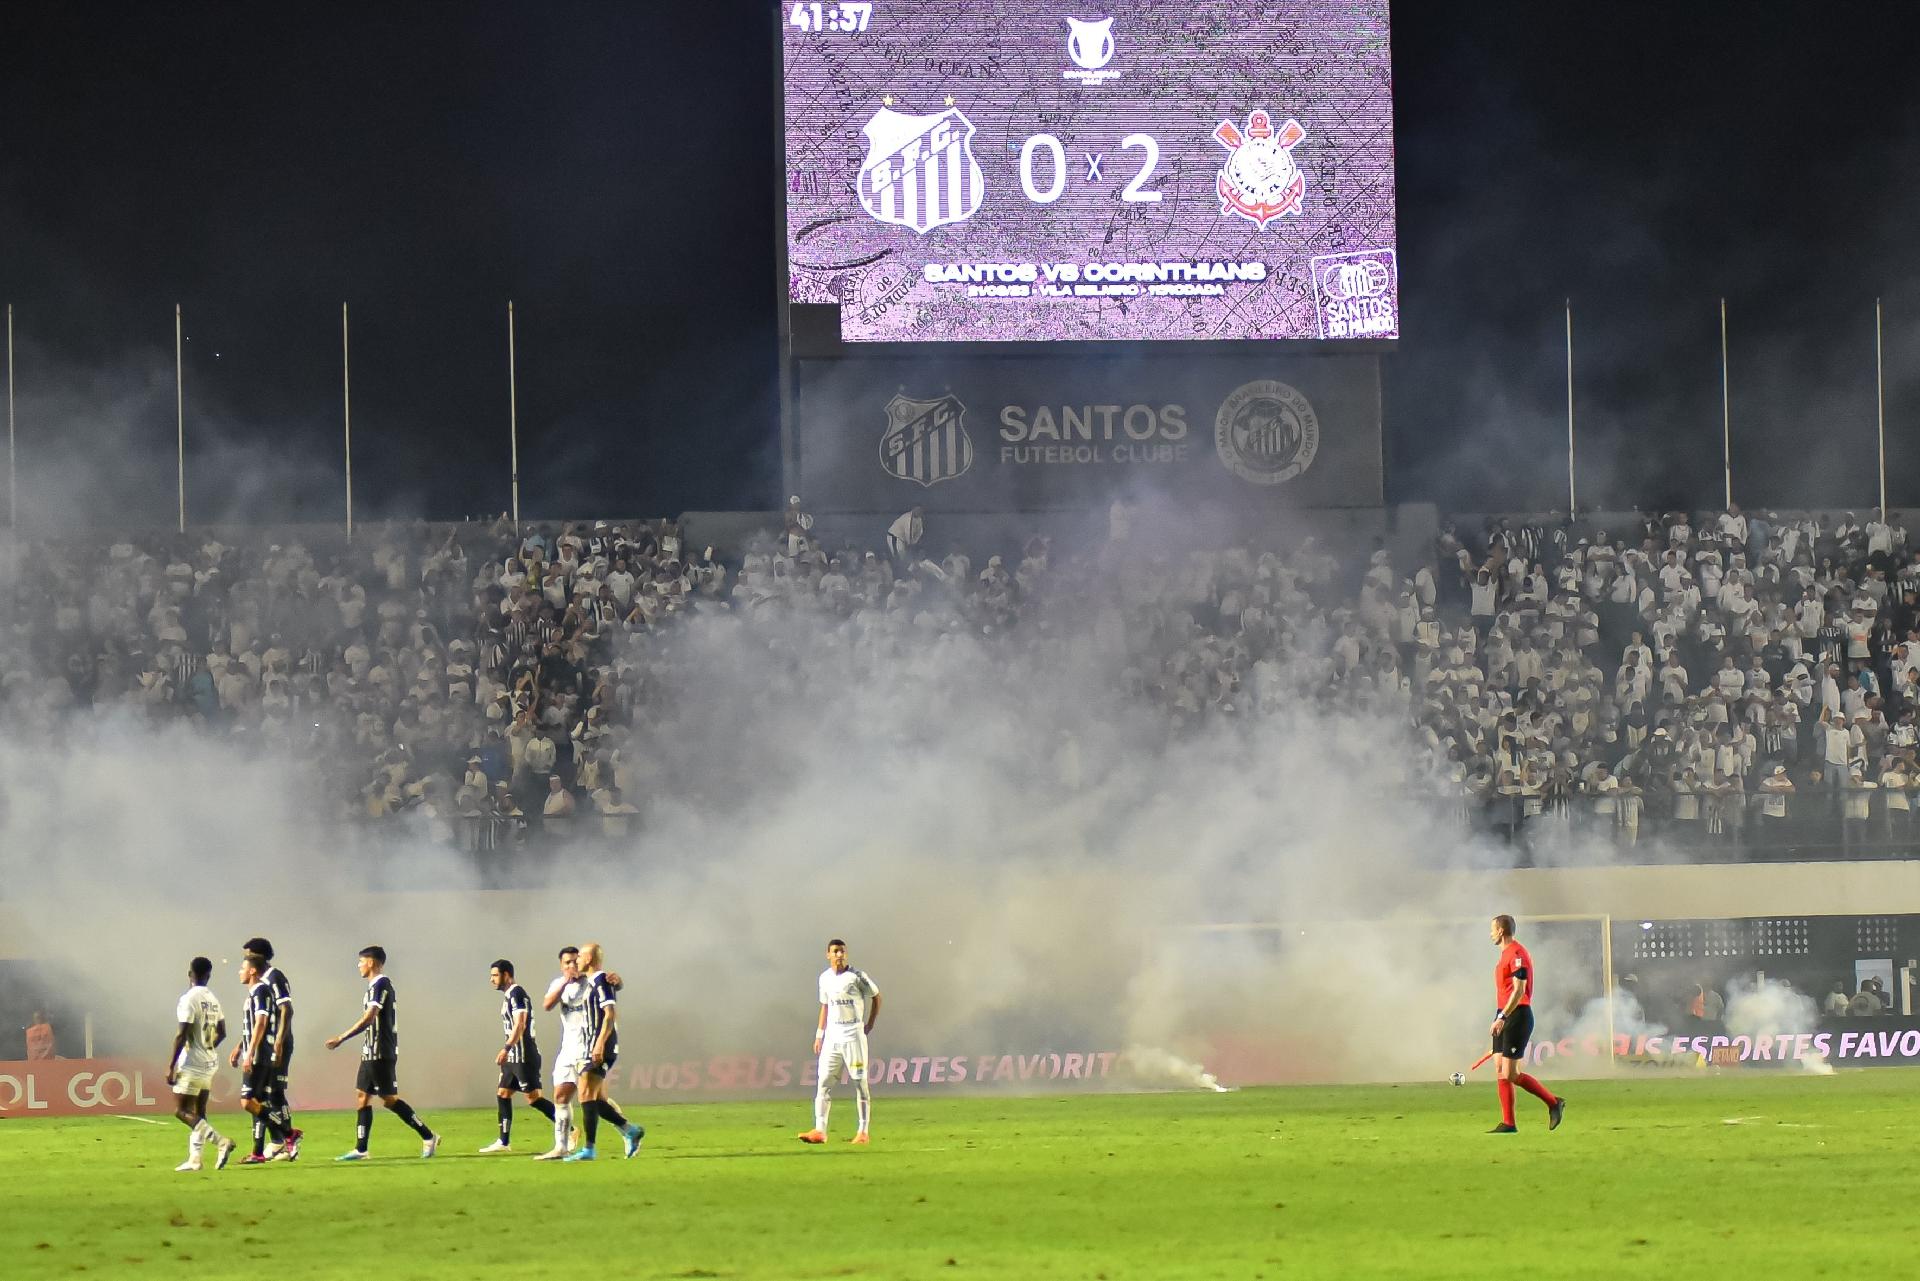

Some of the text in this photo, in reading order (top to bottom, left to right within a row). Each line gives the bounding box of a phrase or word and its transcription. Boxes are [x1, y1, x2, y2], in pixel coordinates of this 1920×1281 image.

[790, 2, 872, 32] 41:37
[1020, 133, 1066, 203] 0
[1122, 133, 1162, 201] 2
[924, 262, 1267, 282] SANTOS VS CORINTHIANS
[1326, 296, 1392, 322] SANTOS
[1329, 320, 1347, 336] DO
[1000, 404, 1188, 442] SANTOS
[1001, 444, 1190, 465] FUTEBOL CLUBE
[800, 1055, 968, 1086] EORTES
[68, 1071, 156, 1108] GOL
